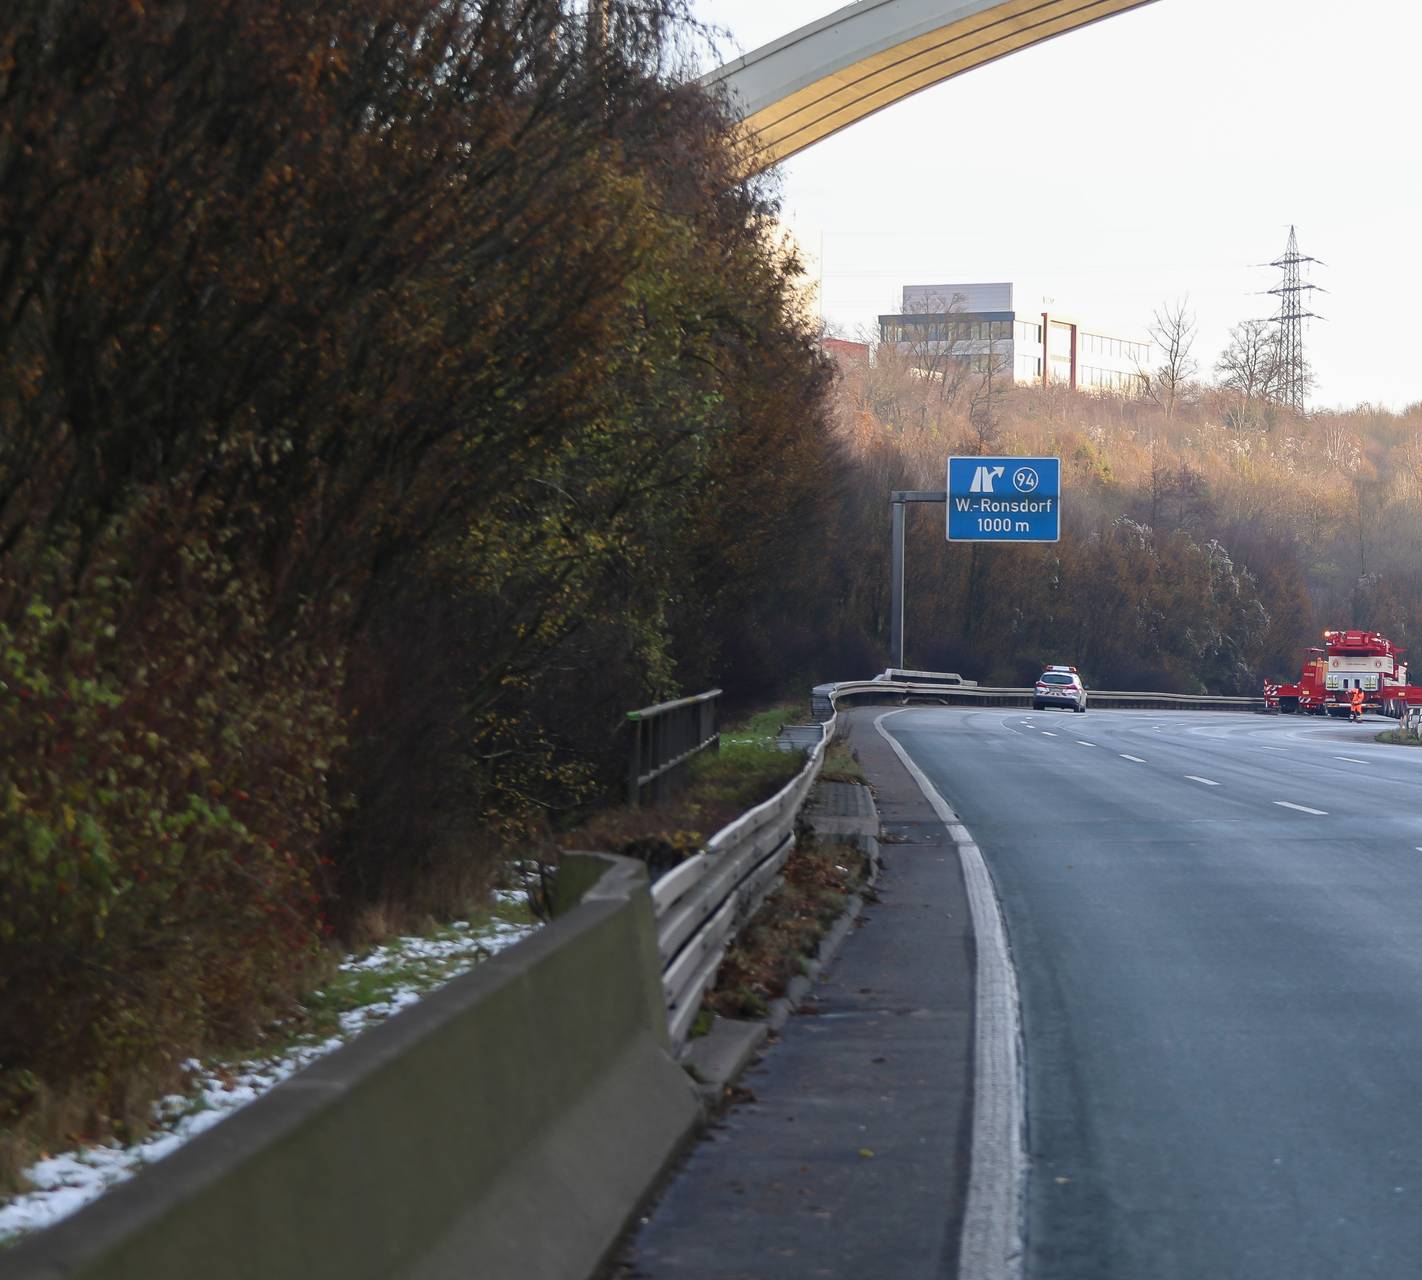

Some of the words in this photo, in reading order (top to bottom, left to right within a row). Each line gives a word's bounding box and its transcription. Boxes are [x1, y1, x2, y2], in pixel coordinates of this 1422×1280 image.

[1017, 473, 1035, 487] 94
[955, 498, 1052, 512] W.-Ronsdorf
[977, 518, 1012, 532] 1000
[1015, 521, 1030, 532] m
